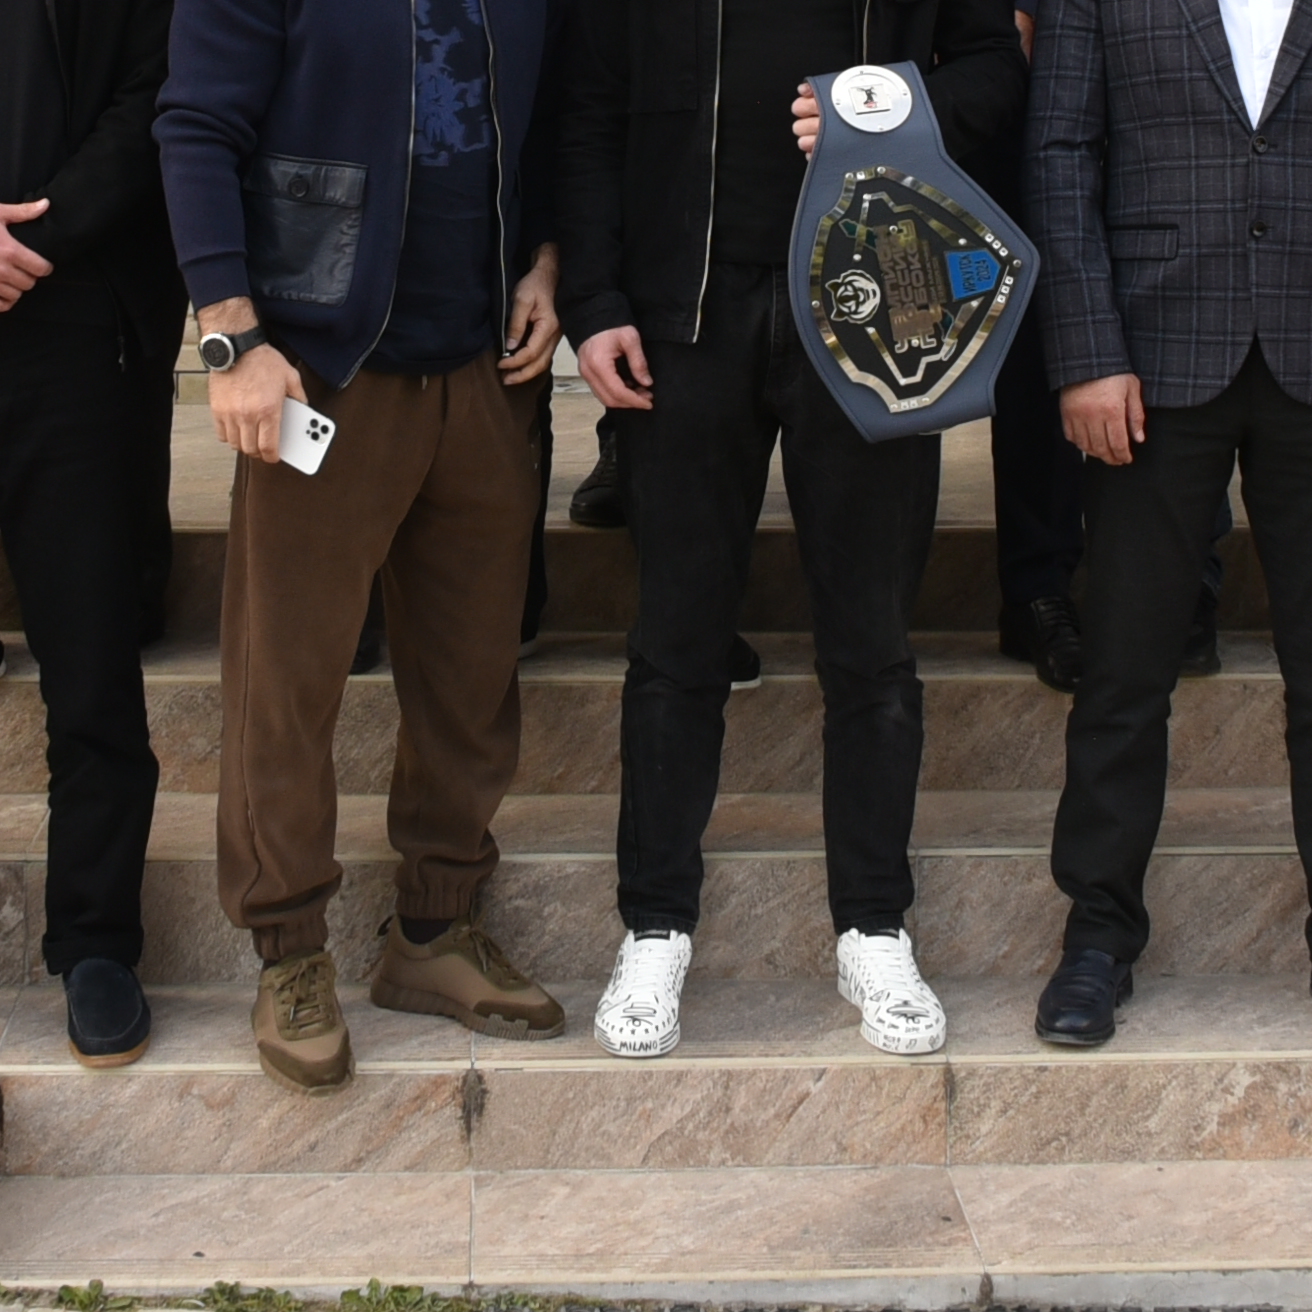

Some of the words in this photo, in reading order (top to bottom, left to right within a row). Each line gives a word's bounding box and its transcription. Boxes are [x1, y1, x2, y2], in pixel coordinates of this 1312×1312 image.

[959, 254, 976, 294] ИРКУТСК
[975, 259, 991, 282] 2024
[619, 1040, 658, 1053] MILANO
